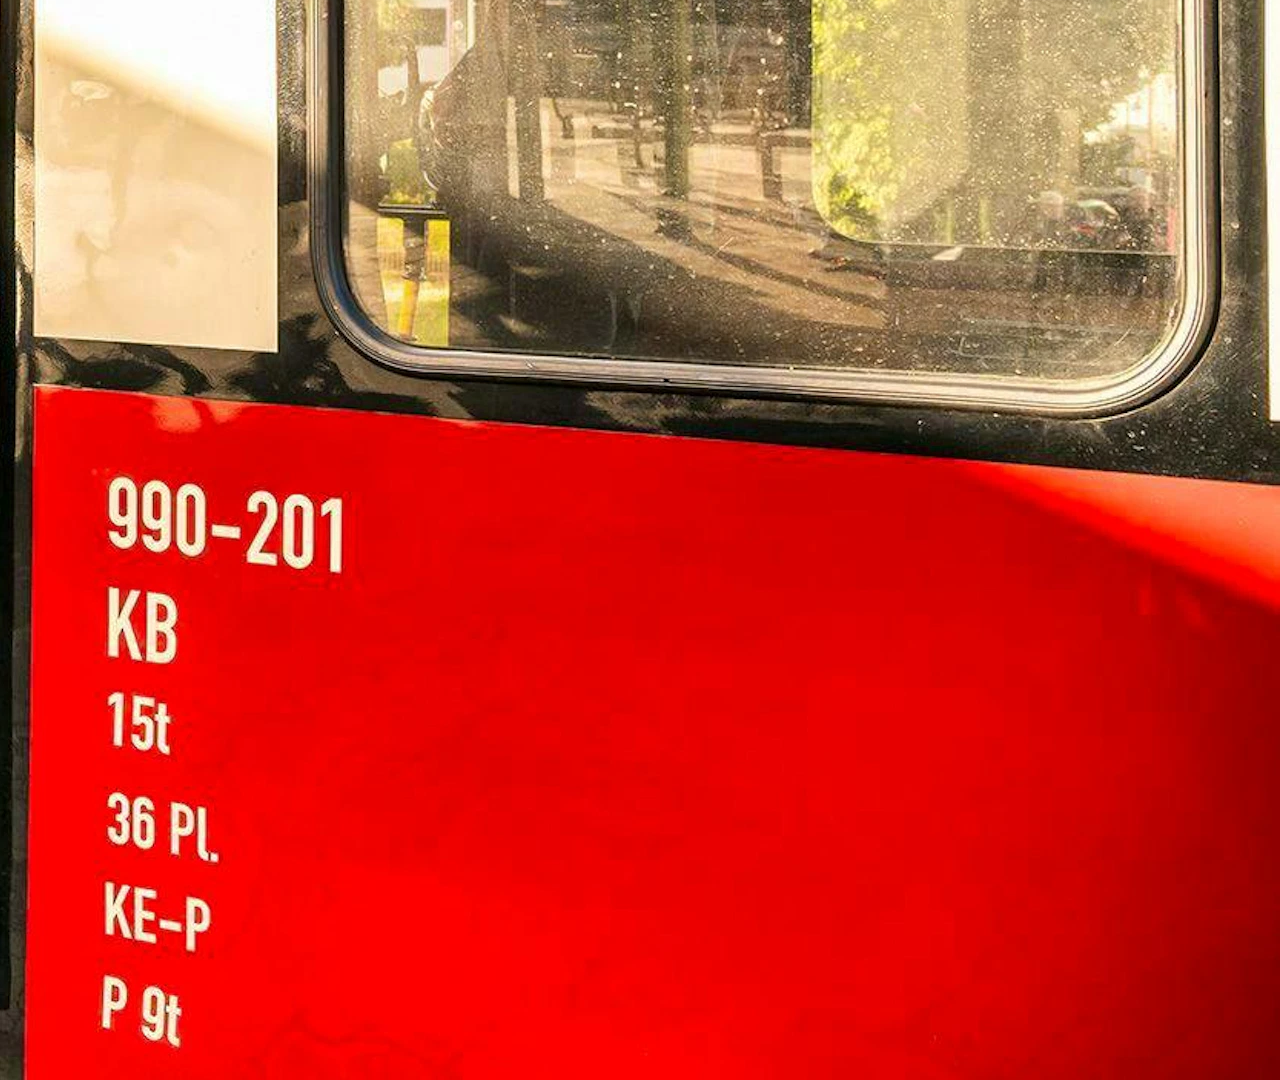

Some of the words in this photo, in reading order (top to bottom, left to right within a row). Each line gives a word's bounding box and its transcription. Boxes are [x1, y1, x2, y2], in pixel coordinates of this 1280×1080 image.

[108, 476, 343, 573] 990-201
[107, 586, 178, 664] KB
[107, 692, 171, 755] 15t
[107, 792, 155, 850] 36
[105, 881, 211, 952] KE-P
[102, 975, 128, 1030] P
[141, 985, 182, 1047] 9t
